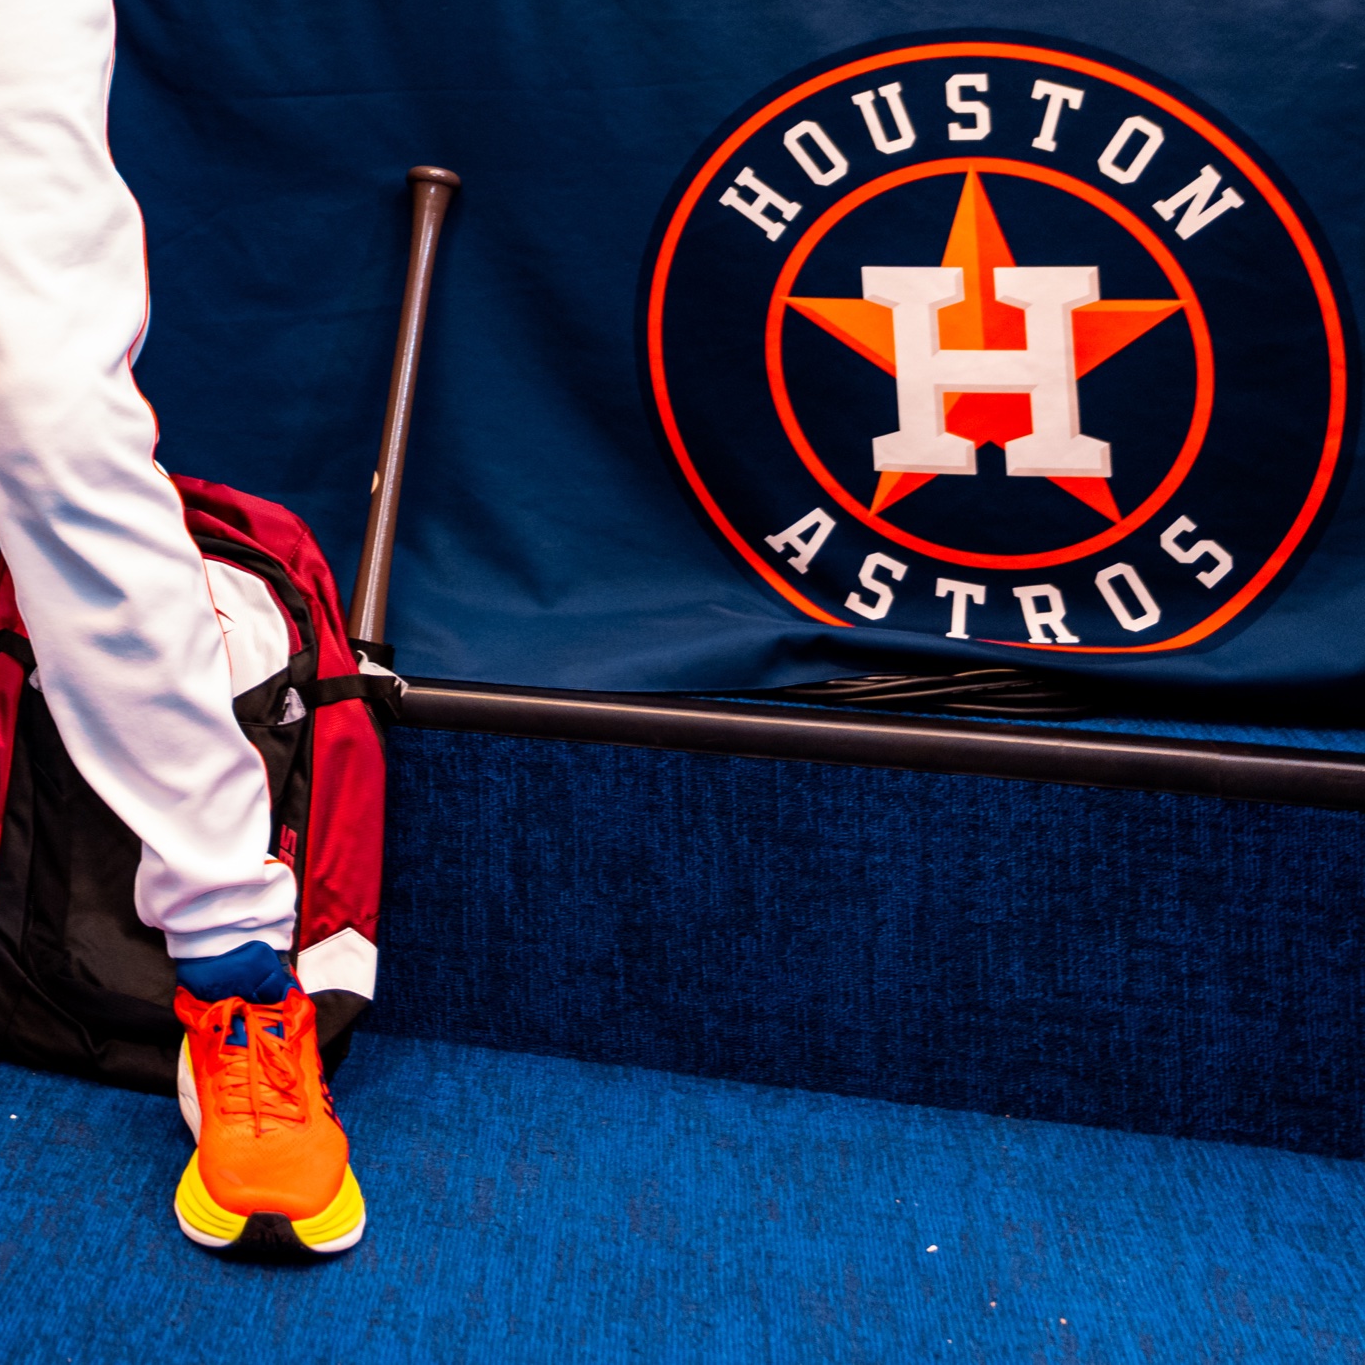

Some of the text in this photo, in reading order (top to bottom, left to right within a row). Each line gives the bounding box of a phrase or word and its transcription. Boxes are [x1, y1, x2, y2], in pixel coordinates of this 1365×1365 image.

[719, 73, 1245, 242] HOUSTON
[861, 265, 1112, 478] H
[764, 507, 1234, 645] ASTROS
